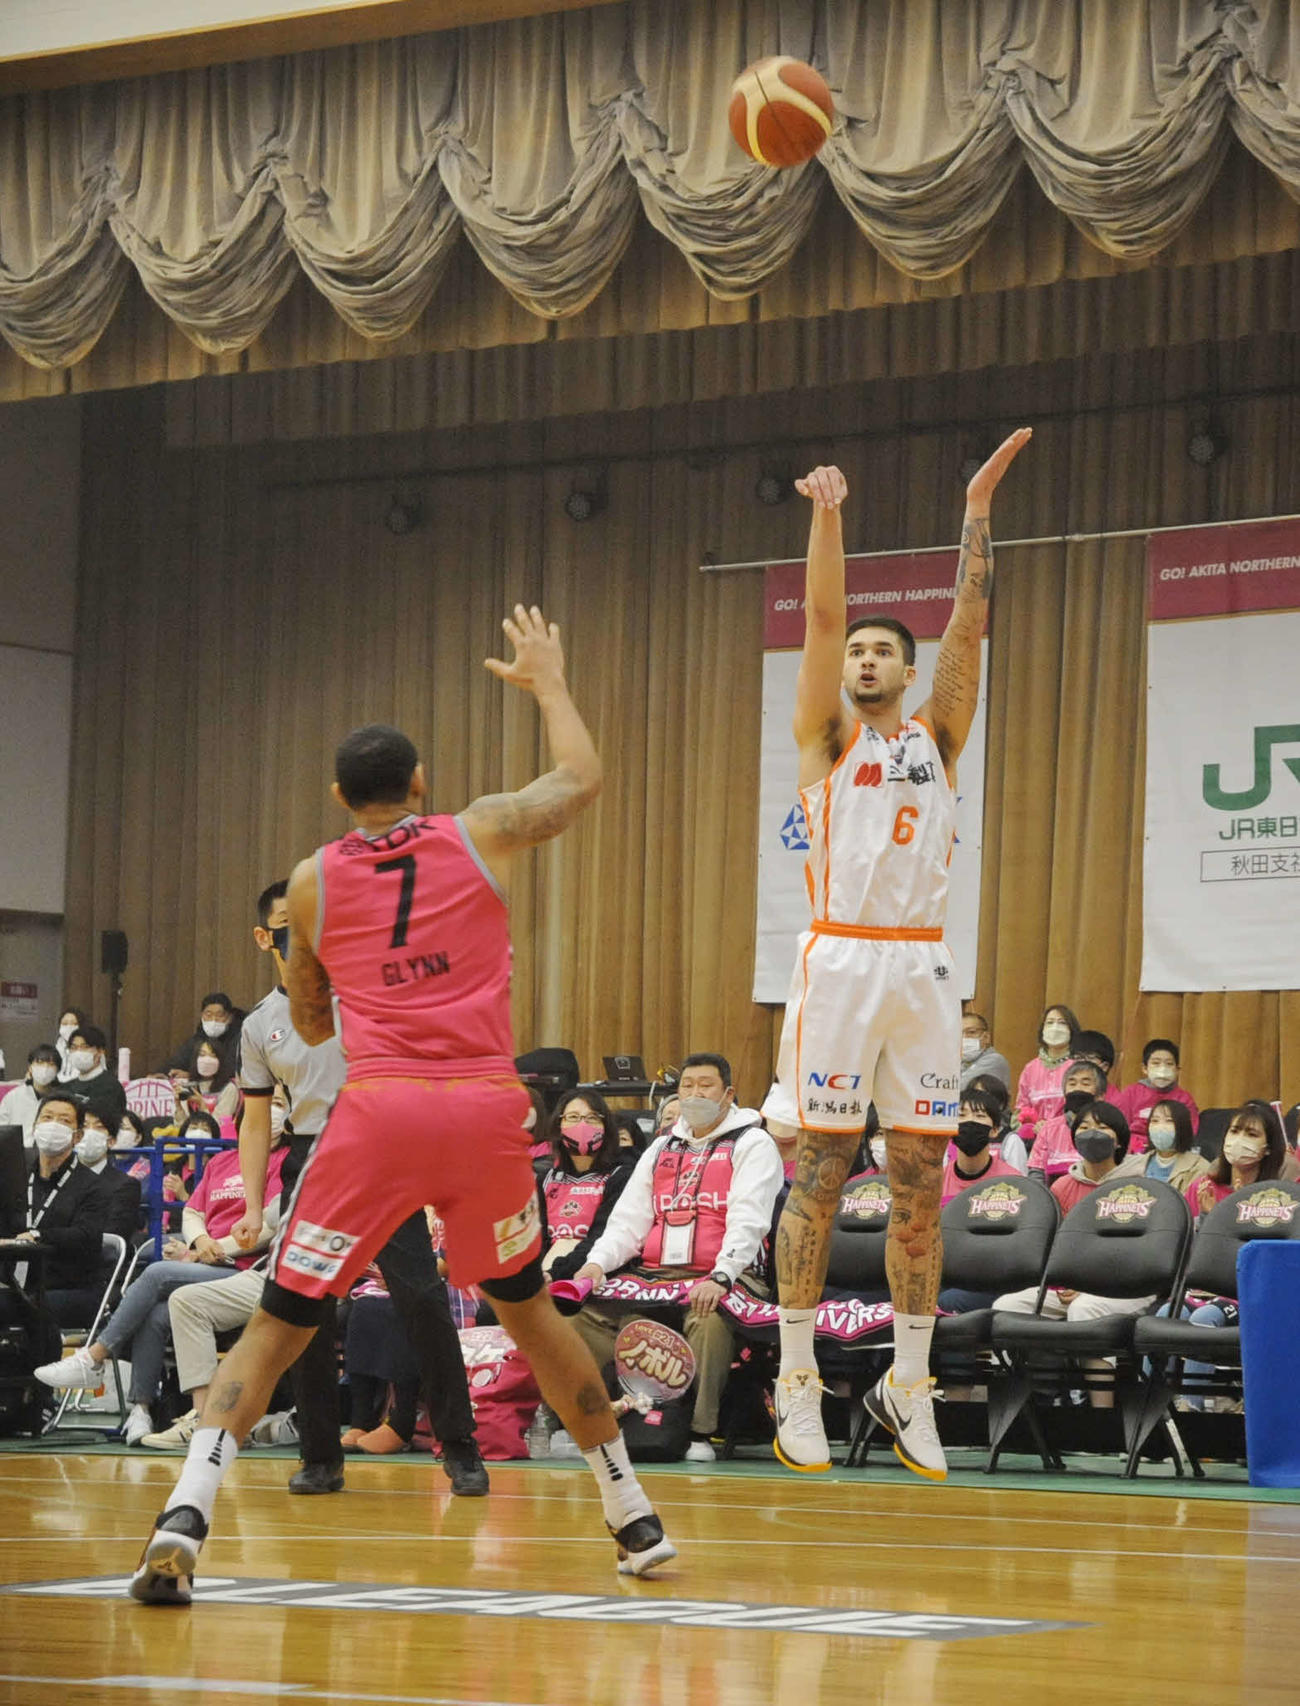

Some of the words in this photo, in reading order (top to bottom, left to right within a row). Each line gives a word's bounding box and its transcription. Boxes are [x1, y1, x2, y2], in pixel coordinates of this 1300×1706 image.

[1160, 567, 1186, 580] GO!
[1188, 562, 1227, 577] AKITA
[1229, 556, 1300, 573] NORTHERN
[774, 598, 798, 611] GO!
[845, 590, 902, 605] ORTHERN
[891, 805, 919, 846] 6
[374, 853, 416, 949] 7
[381, 950, 451, 987] GLYNN
[969, 1196, 1025, 1217] HAPPINETS
[1097, 1199, 1153, 1219] HAPPINETS
[1237, 1202, 1297, 1223] HAPPINETS
[617, 1340, 688, 1388] ノボル
